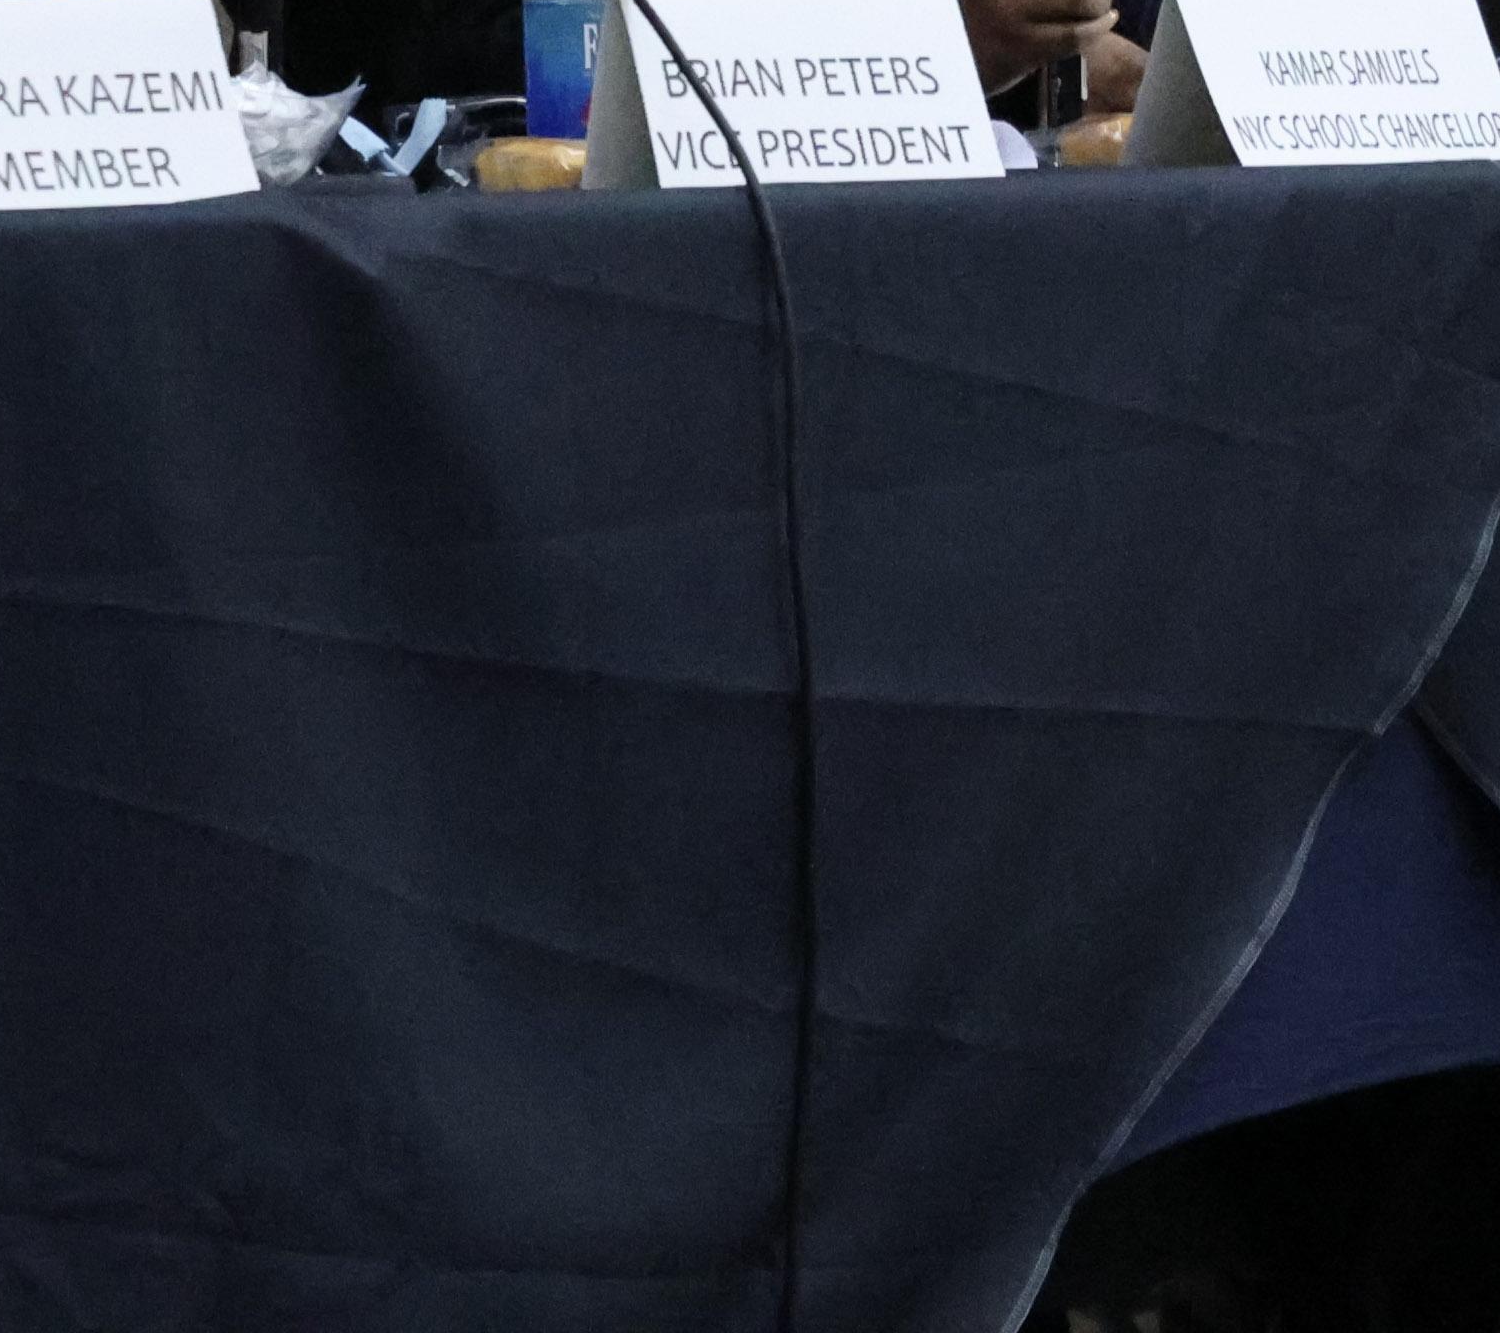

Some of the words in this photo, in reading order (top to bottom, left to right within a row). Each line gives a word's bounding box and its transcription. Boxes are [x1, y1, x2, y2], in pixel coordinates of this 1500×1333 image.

[661, 58, 785, 98] BRIAN
[795, 56, 940, 96] PETERS
[1258, 49, 1343, 86] KAMAR
[1338, 47, 1440, 85] SAMUELS
[54, 70, 225, 114] KAZEMI
[756, 126, 970, 168] PRESIDENT
[1233, 114, 1285, 150] NYC
[1279, 113, 1380, 149] SCHOOLS
